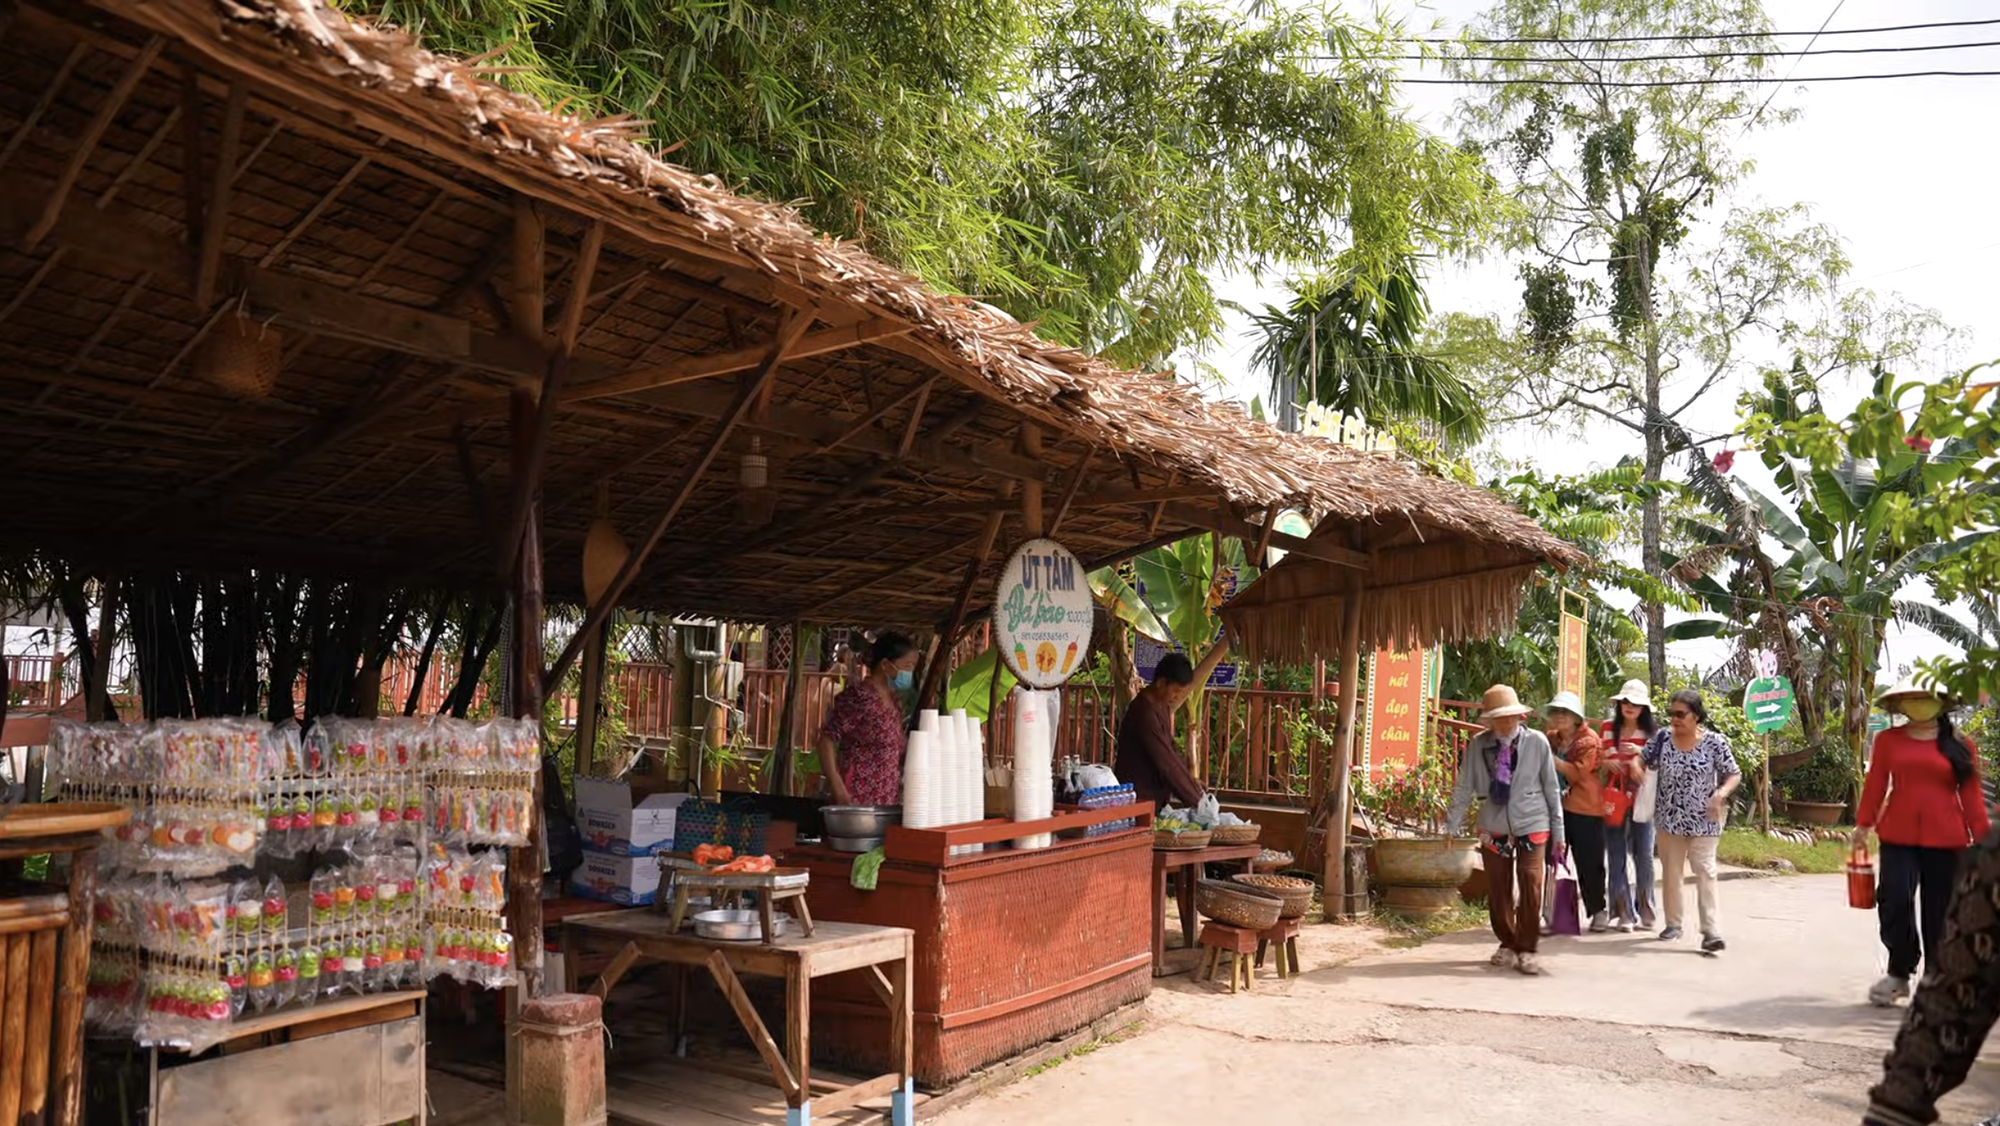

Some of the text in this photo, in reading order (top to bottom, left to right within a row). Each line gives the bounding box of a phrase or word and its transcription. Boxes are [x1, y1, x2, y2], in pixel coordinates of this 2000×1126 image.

[1022, 549, 1075, 591] ÚT TÂM
[1389, 672, 1409, 687] nét
[1386, 698, 1409, 719] đẹp
[1381, 725, 1411, 741] chân
